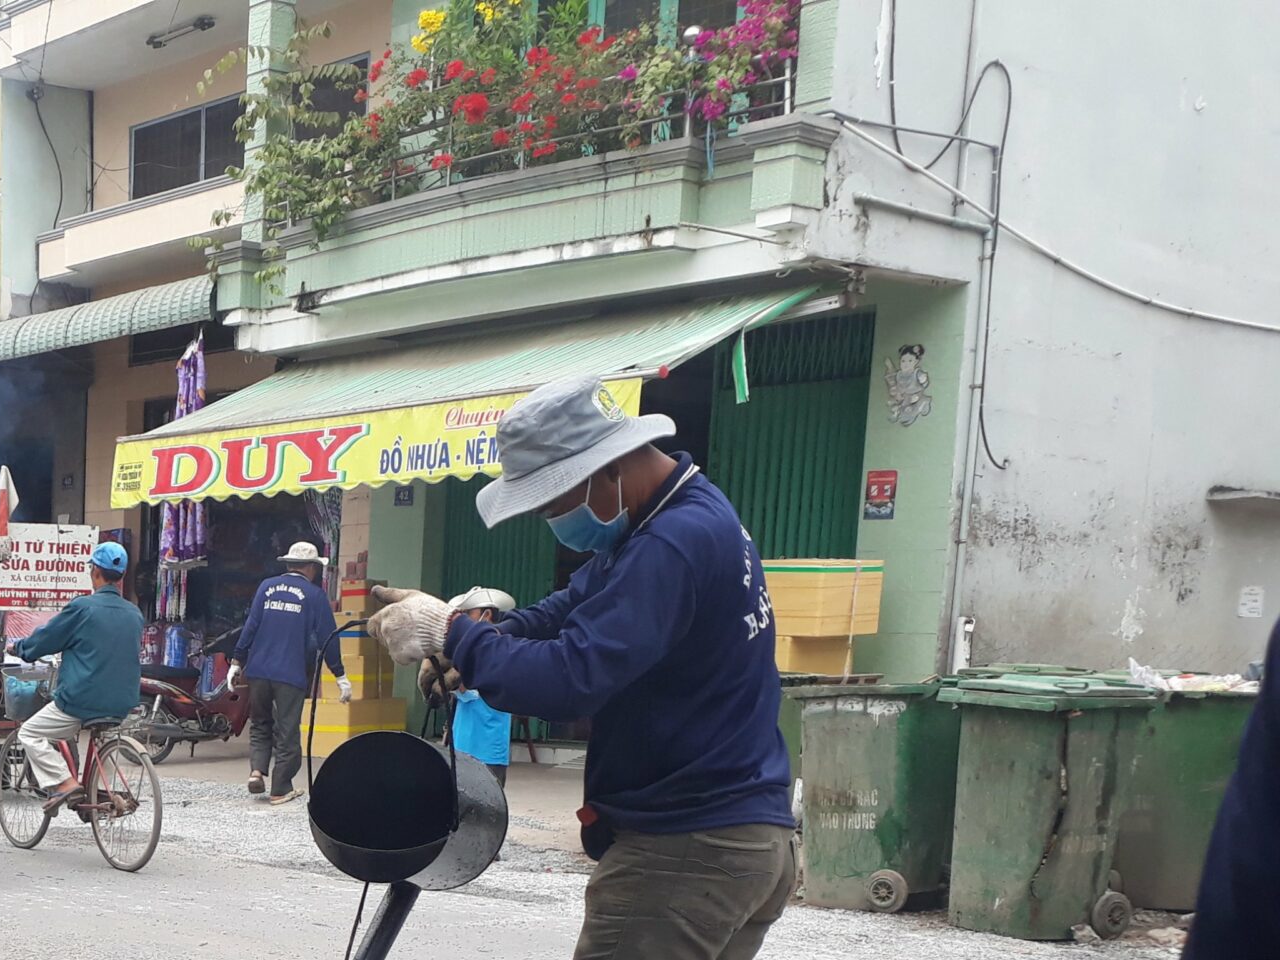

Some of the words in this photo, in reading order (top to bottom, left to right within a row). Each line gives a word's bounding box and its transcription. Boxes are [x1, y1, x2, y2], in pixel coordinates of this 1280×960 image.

[148, 424, 370, 496] DUY
[379, 435, 402, 475] ĐỒ
[406, 438, 450, 475] NHỰA
[25, 539, 45, 554] TỪ
[48, 541, 92, 558] THIỆN
[35, 557, 85, 573] ĐƯỜNG
[25, 573, 47, 583] CHÂU
[50, 576, 78, 584] PHONG
